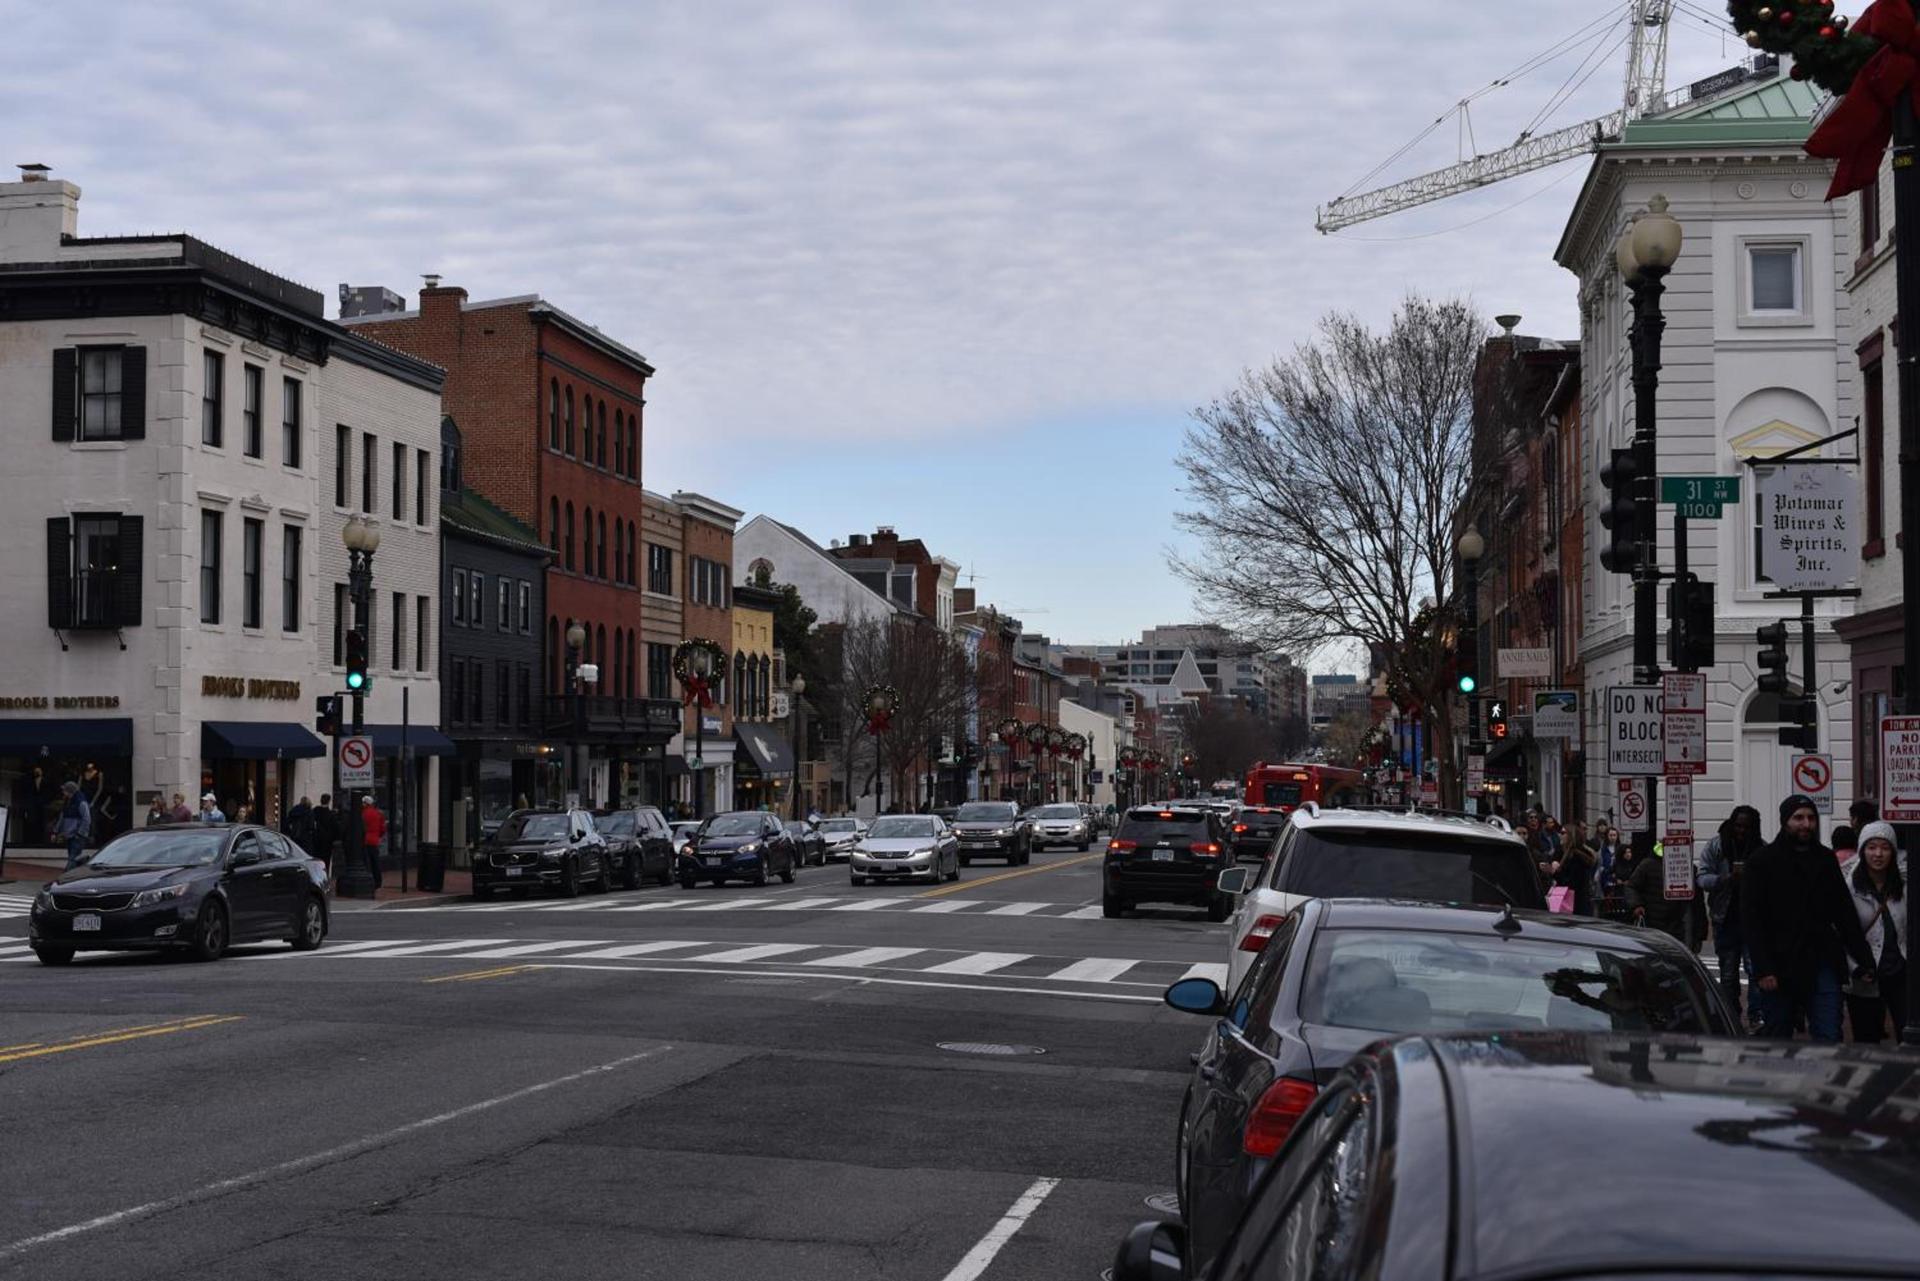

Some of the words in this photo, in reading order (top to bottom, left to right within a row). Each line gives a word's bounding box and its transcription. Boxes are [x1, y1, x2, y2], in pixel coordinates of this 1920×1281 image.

[1686, 481, 1702, 500] 31
[1715, 481, 1726, 489] ST
[1713, 490, 1729, 499] NW
[1683, 503, 1716, 517] 1100
[1775, 494, 1844, 512] Potomac
[1774, 514, 1825, 530] Wines
[1833, 515, 1846, 530] &
[1779, 535, 1847, 554] Spirits,
[1795, 555, 1831, 571] Inc.
[201, 676, 245, 698] BROOKS
[248, 678, 301, 701] BROTHERS
[54, 696, 120, 709] BROTHERS
[1614, 695, 1635, 713] DO
[1644, 695, 1664, 713] NO
[1901, 733, 1919, 744] NO
[1612, 750, 1663, 764] INTERSECTI
[1890, 744, 1920, 755] PARKI
[1887, 757, 1916, 770] LOADING
